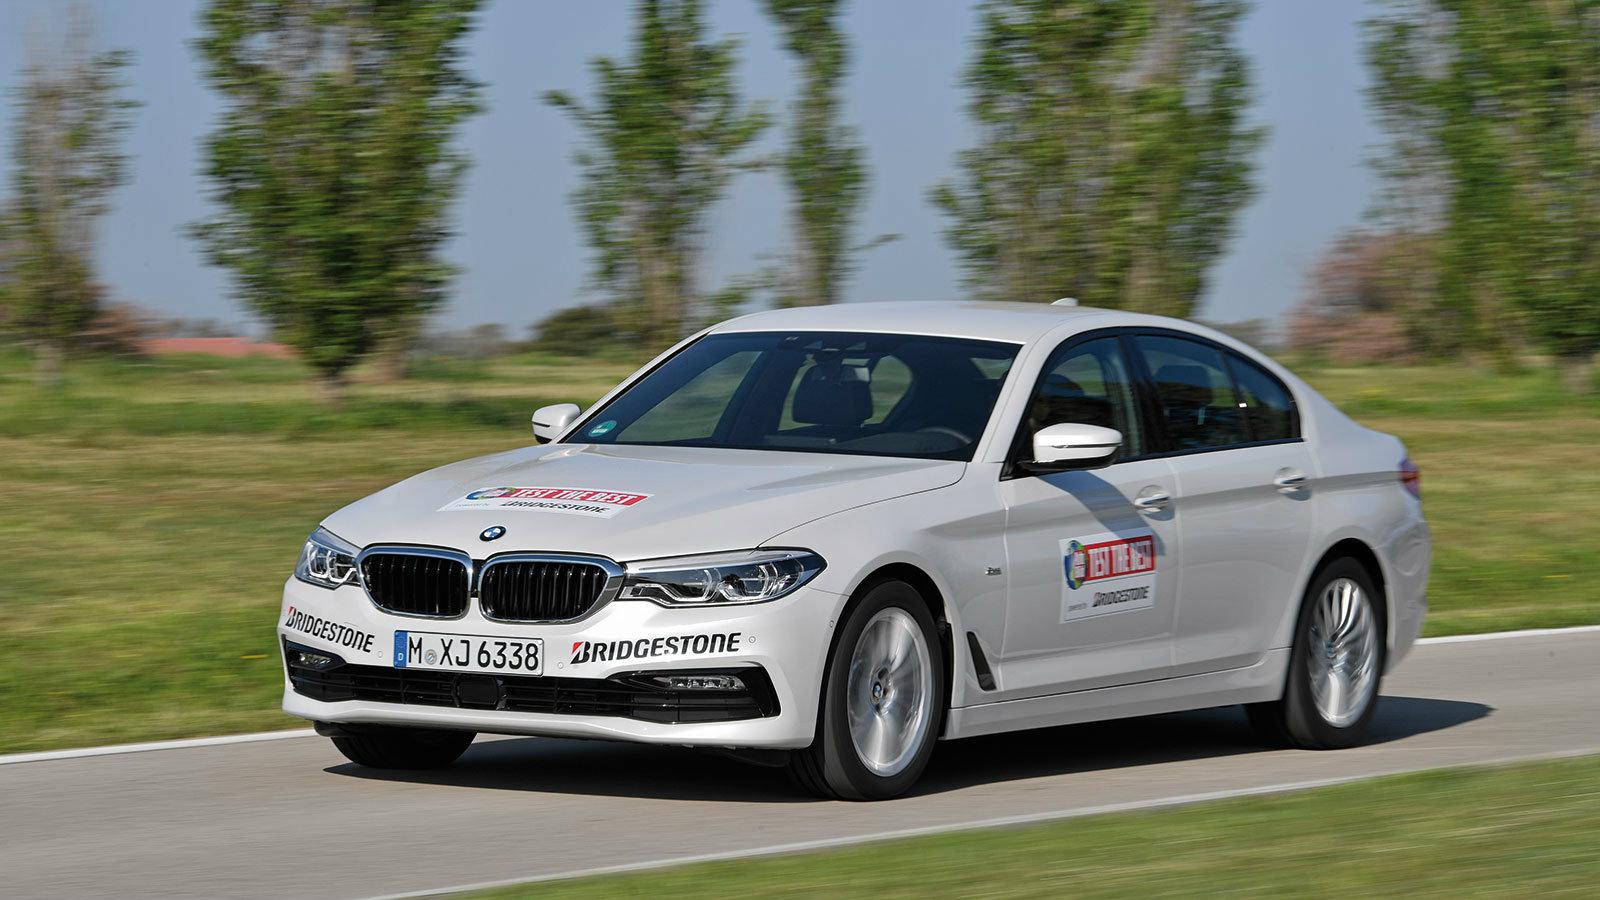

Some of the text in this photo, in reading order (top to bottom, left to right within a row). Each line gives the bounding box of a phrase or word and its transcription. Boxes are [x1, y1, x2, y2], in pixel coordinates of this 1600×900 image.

[501, 500, 610, 513] BRIDGESTONE
[513, 489, 552, 498] TEST
[556, 490, 590, 501] THE
[587, 492, 637, 504] BEST
[1092, 586, 1150, 607] BRIDGESTONE
[285, 606, 375, 653] BRIDGESTONE
[408, 636, 539, 671] M XJ 6338
[570, 632, 742, 664] BRIDGESTONE
